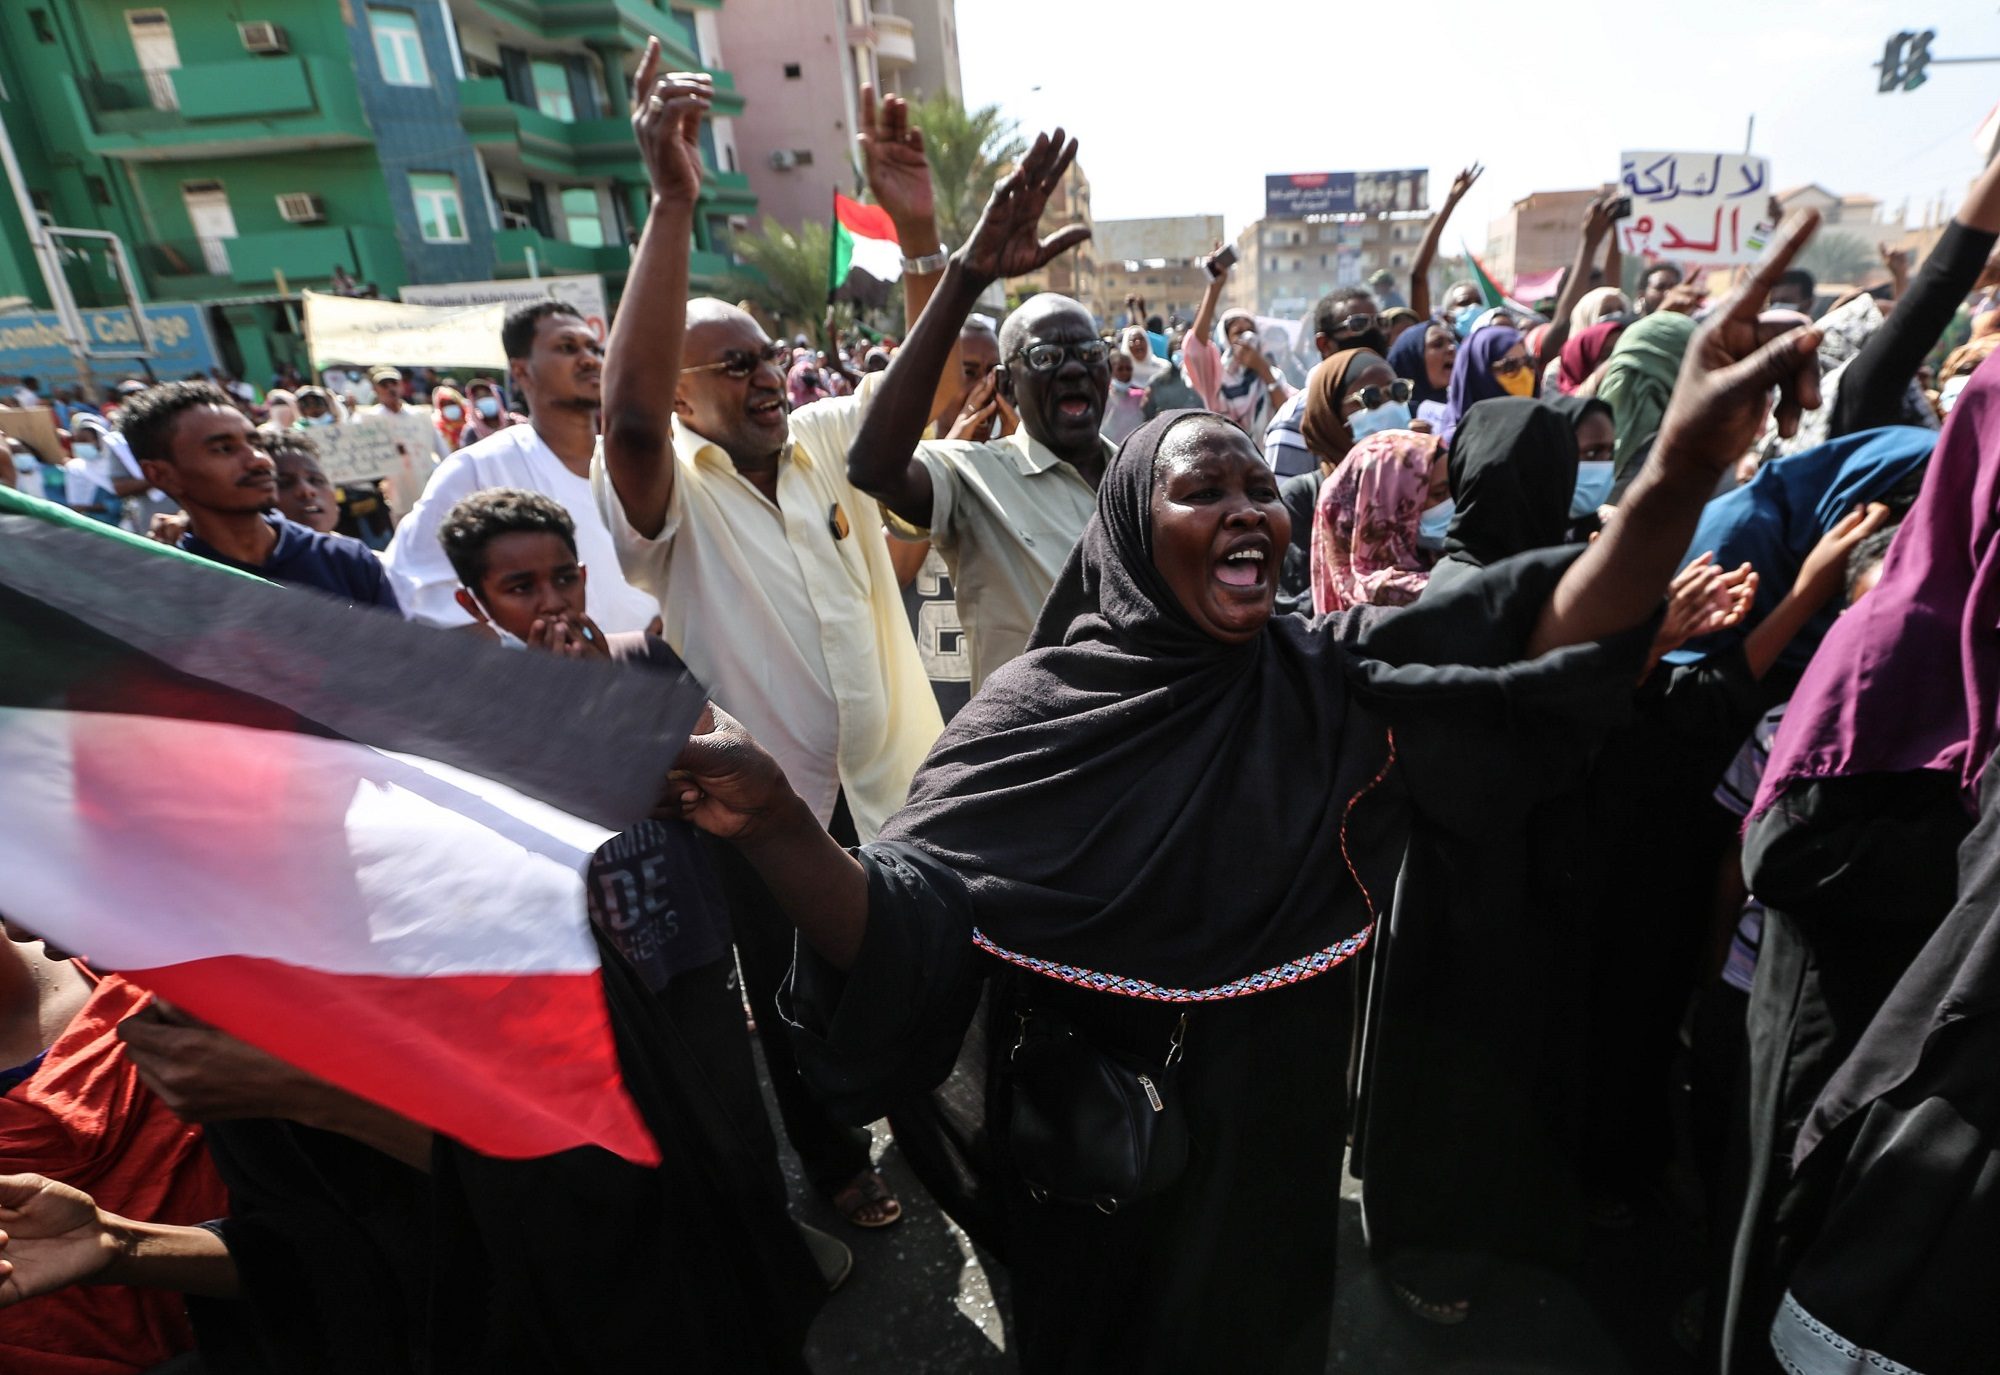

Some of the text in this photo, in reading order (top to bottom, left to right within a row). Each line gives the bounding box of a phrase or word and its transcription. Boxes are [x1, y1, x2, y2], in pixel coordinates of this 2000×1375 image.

[1725, 160, 1765, 199] لا
[1623, 203, 1741, 257] الدم
[93, 314, 191, 347] Colege
